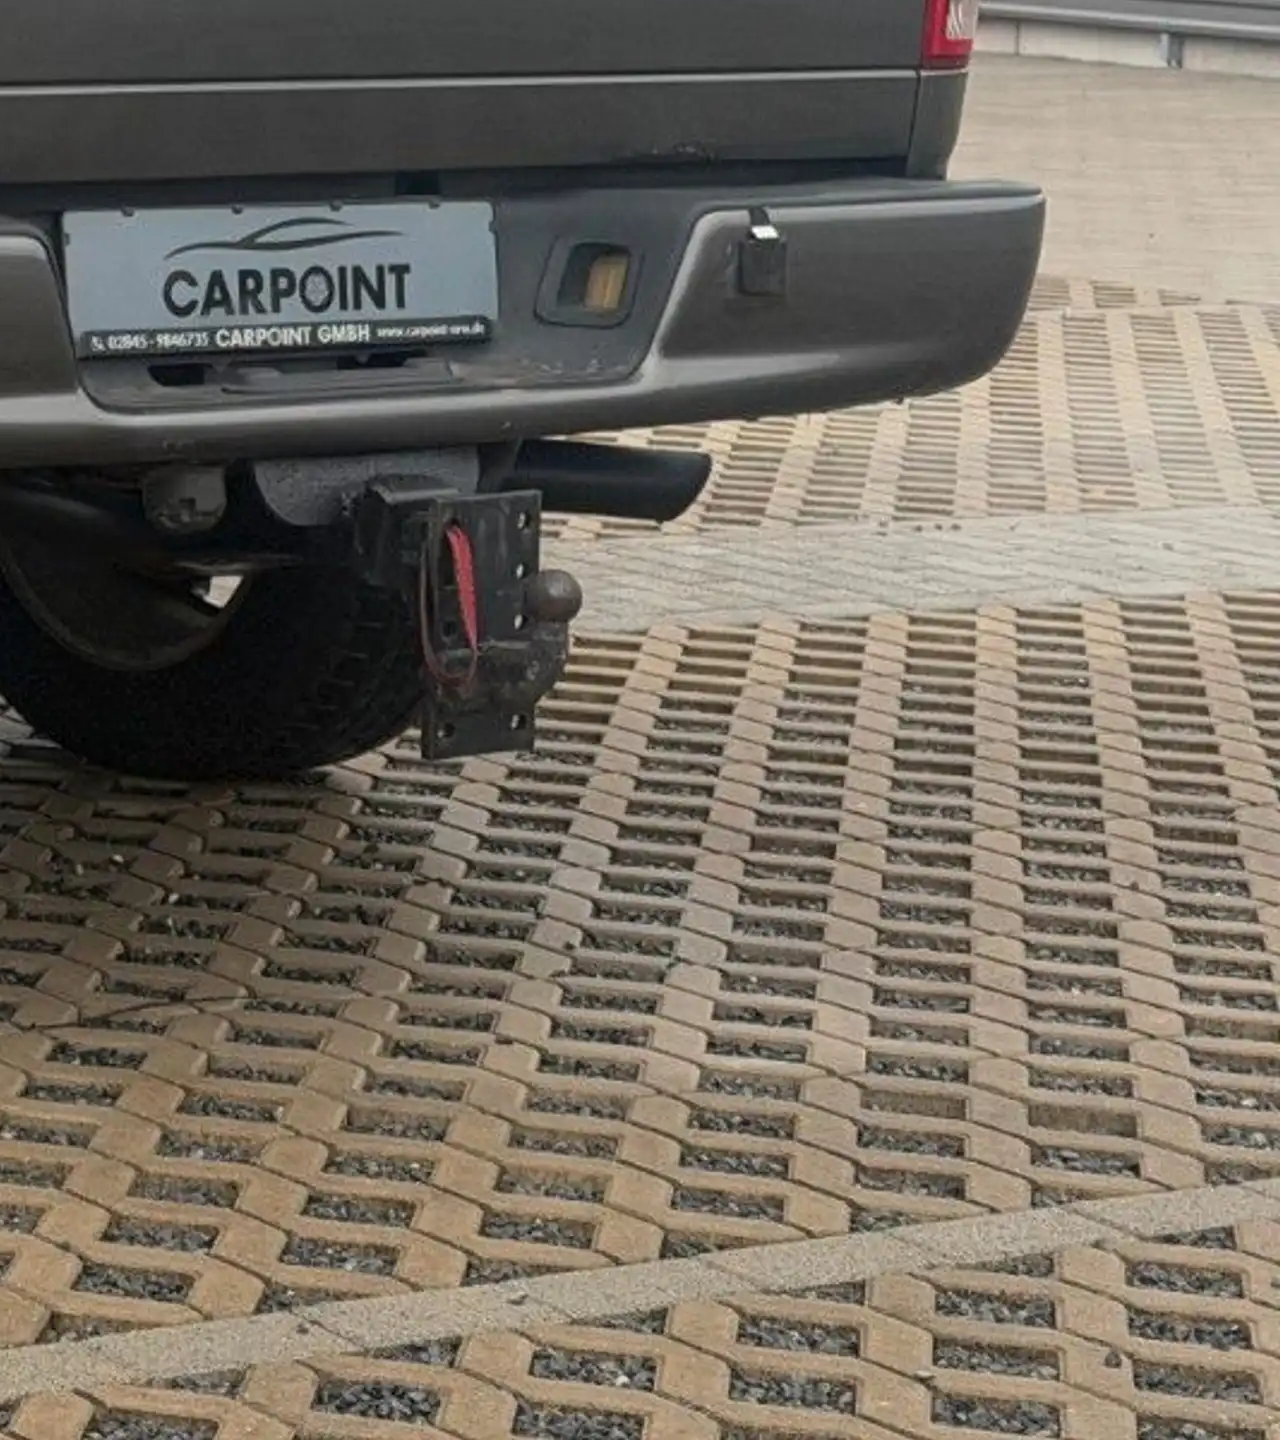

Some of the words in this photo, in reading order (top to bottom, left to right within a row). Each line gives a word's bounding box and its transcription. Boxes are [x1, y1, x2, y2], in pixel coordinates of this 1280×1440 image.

[162, 262, 412, 319] CARPOINT
[215, 325, 312, 348] CARPOINT
[317, 323, 370, 344] GMBH
